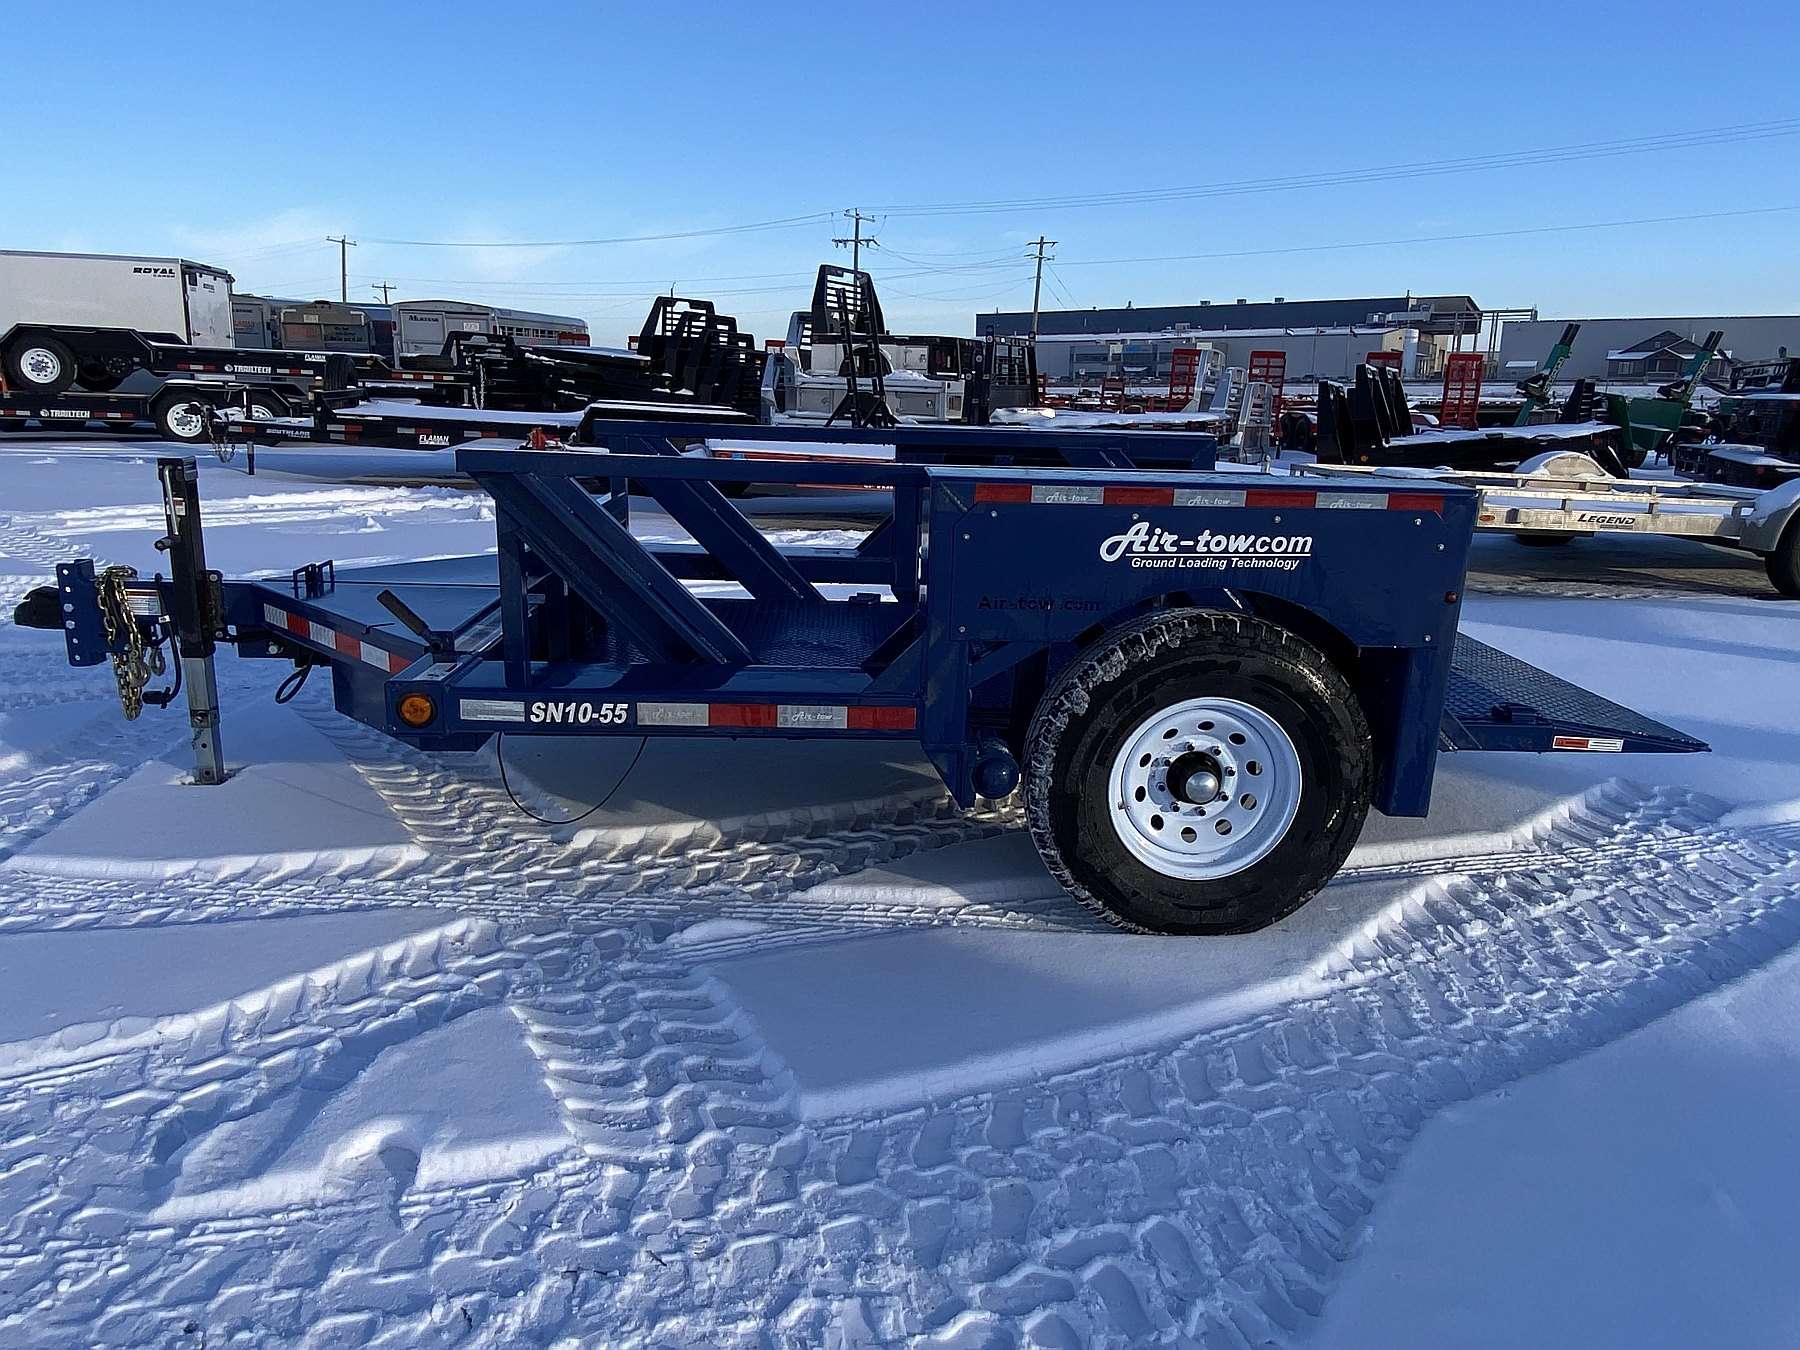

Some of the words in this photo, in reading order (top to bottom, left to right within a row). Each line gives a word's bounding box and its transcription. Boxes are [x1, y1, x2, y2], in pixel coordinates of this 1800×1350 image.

[234, 364, 271, 374] TRAILTECH
[50, 409, 90, 418] TRAILTECH
[419, 434, 449, 442] FLAMAN
[1045, 491, 1088, 503] Air-tow
[1187, 493, 1230, 506] Air-tow
[1577, 513, 1636, 525] LEGEND
[1099, 521, 1313, 562] Air-tow.com
[1131, 557, 1176, 568] Ground
[1178, 557, 1227, 571] Loading
[1231, 557, 1300, 571] Technology
[530, 701, 629, 724] SN10-55
[792, 710, 833, 722] Air-tow
